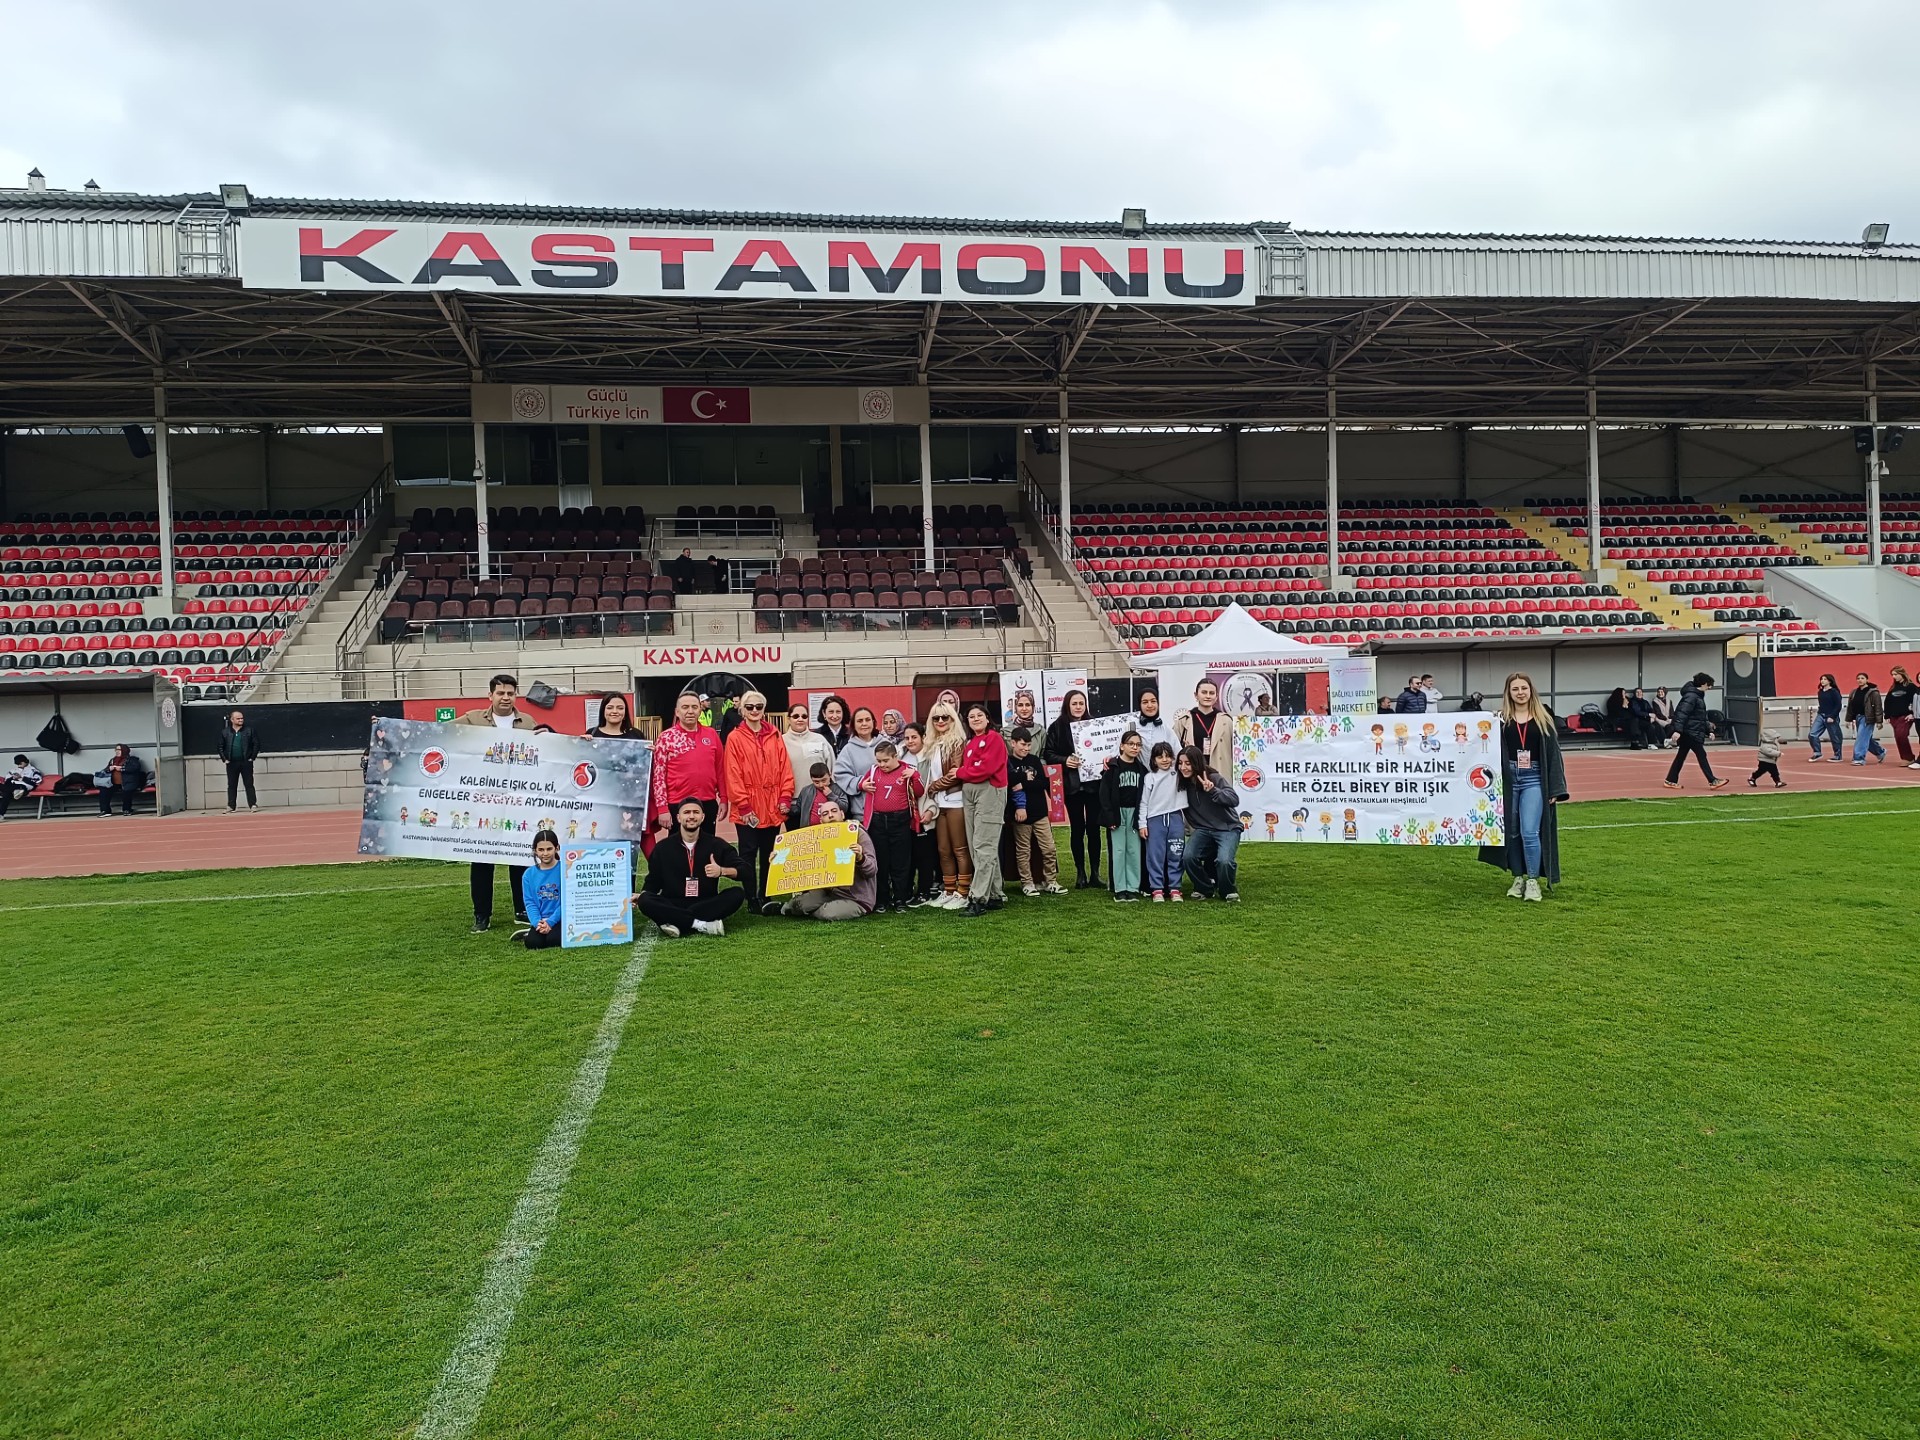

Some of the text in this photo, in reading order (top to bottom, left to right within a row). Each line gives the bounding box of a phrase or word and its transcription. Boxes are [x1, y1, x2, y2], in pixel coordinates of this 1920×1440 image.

[299, 227, 1244, 299] KASTAMONU
[587, 388, 628, 403] Güçlü
[566, 404, 649, 421] Türkiye İçin
[643, 646, 781, 665] KASTAMONU
[1208, 656, 1323, 669] KASTAMONU İL SAĞLIK MÜDÜRLÜĞÜ
[1331, 703, 1364, 713] HAREKET
[1275, 758, 1455, 773] HER FARKLILIK BİR HAZİNE
[460, 775, 508, 789] KALBİNLE
[509, 780, 528, 791] IŞIK
[529, 782, 542, 791] OL
[1281, 779, 1450, 796] HER ÖZEL BİREY BİR IŞIK
[884, 785, 892, 799] 7
[418, 788, 593, 812] ENGELLER SEVGİYLE AYDINLANSIN!
[575, 871, 615, 879] HASTALIK
